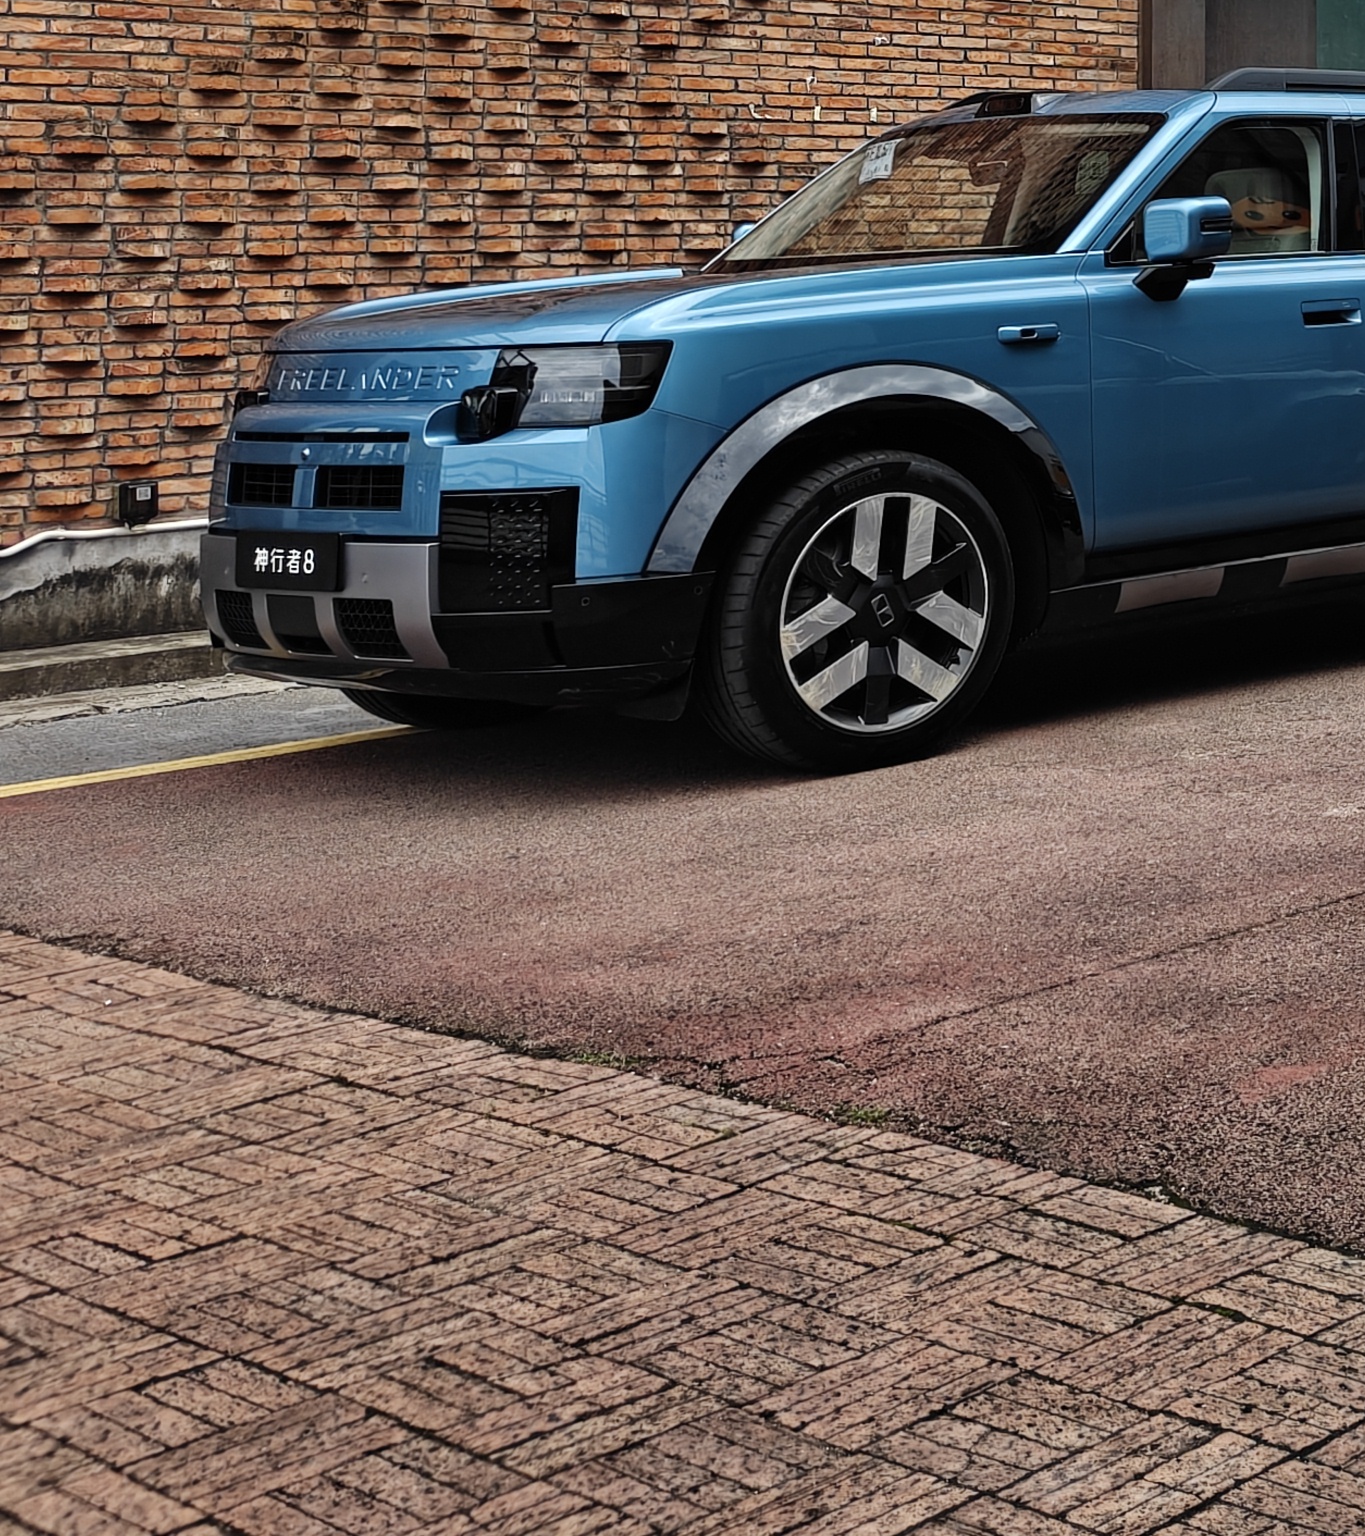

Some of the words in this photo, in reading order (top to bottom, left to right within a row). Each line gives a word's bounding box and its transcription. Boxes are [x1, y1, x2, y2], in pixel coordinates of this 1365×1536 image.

[277, 366, 461, 391] FREELANDER
[253, 546, 315, 574] 神行者8
